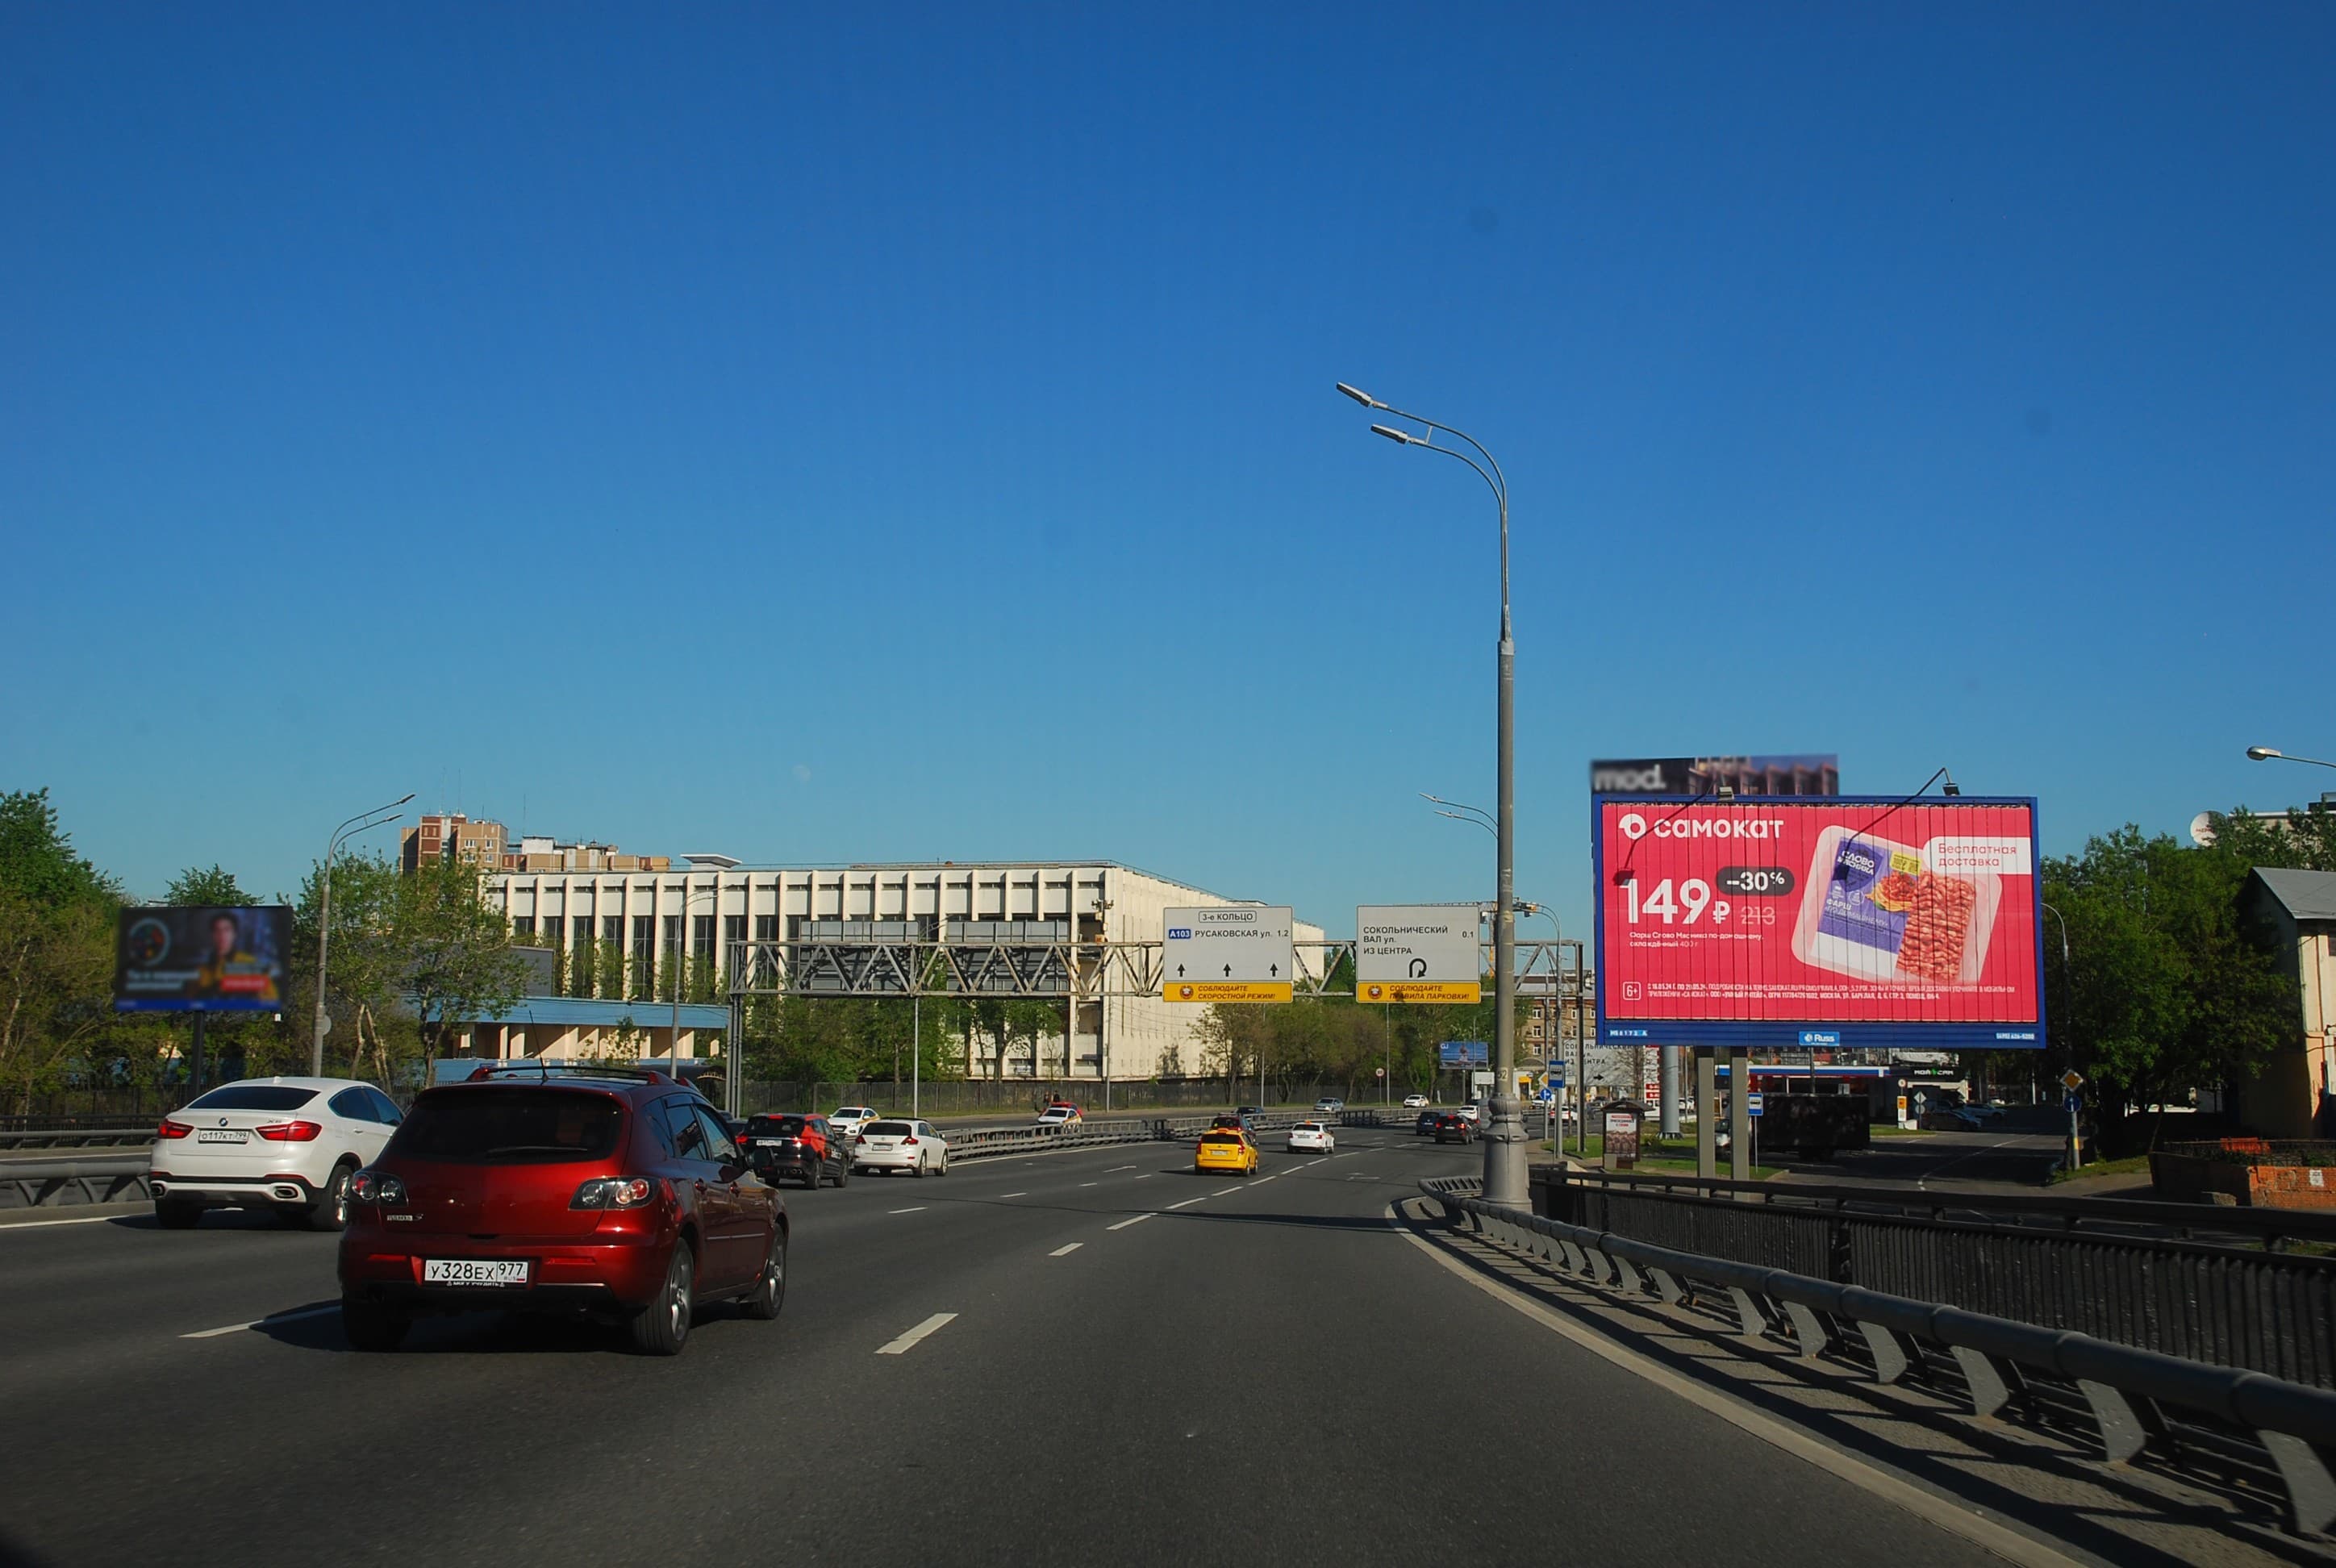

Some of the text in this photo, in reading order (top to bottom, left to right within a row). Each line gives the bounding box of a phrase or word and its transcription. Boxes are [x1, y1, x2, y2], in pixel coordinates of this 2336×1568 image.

[1938, 843, 2017, 855] Бесплатная
[1938, 857, 2000, 867] доставка
[1216, 913, 1254, 922] КОЛЬЦО
[1195, 929, 1258, 938] РУСАКОВСКАЯ
[1260, 930, 1273, 939] ул.
[1277, 929, 1290, 937] 1.2
[1363, 925, 1475, 939] СОКОЛЬНИЧЕСКИЙ 0.1
[1383, 936, 1397, 945] ул.
[1363, 947, 1412, 956] ИЗ ЦЕНТРА
[1626, 985, 1638, 997] 6+
[1814, 1034, 1835, 1042] Russ
[431, 1262, 524, 1280] У328ЕХ 977
